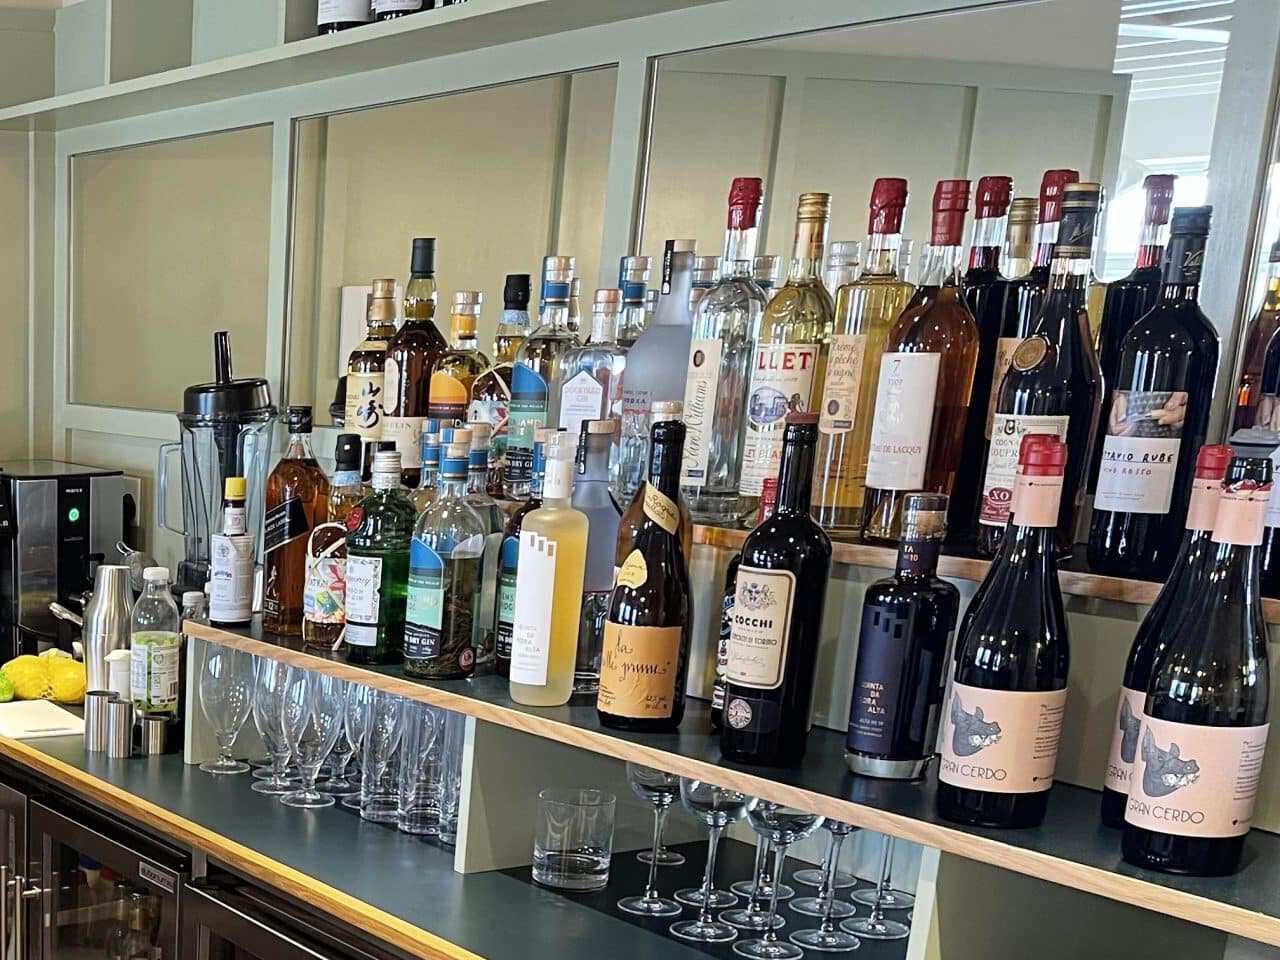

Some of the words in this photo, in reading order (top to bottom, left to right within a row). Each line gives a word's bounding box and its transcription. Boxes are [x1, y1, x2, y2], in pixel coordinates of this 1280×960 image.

[991, 489, 1011, 501] XO
[734, 615, 773, 629] COCCHI
[960, 764, 1008, 781] CERDO
[1152, 805, 1205, 824] CERDO
